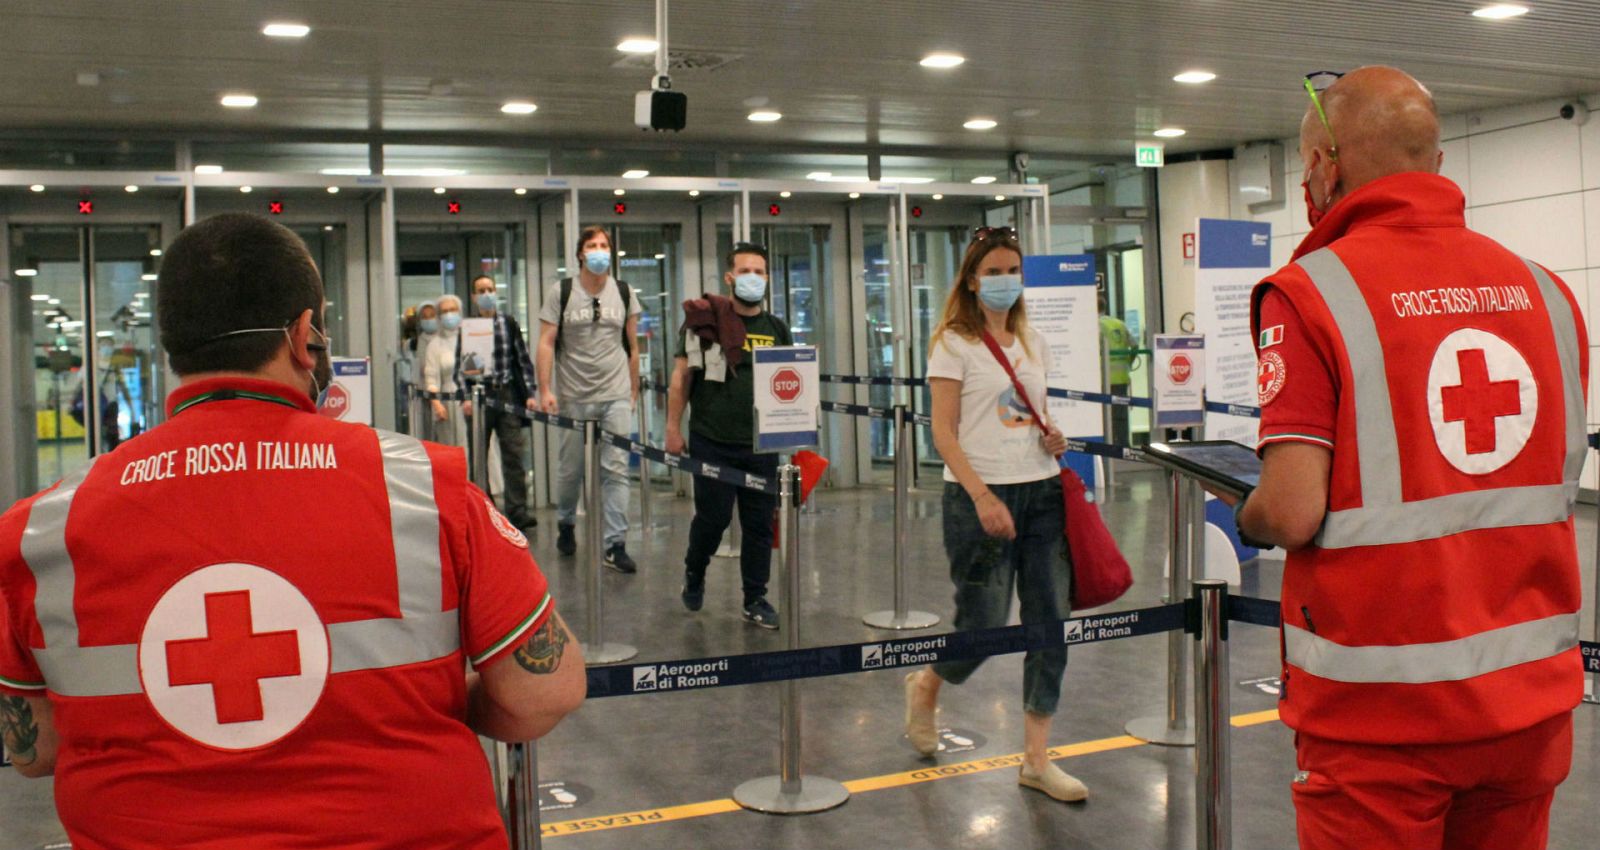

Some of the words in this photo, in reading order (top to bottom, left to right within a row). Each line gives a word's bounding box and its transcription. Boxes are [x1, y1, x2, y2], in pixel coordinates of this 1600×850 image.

[1391, 289, 1441, 318] CROCE
[1438, 287, 1480, 314] ROSSA
[1477, 285, 1533, 313] ITALIANA
[1170, 365, 1190, 375] STOP
[775, 381, 799, 391] STOP
[120, 450, 178, 486] CROCE
[185, 441, 247, 476] ROSSA
[256, 440, 338, 470] ITALIANA
[1083, 612, 1139, 630] Aeroporti
[1084, 629, 1095, 641] di
[1098, 626, 1132, 639] Roma
[884, 636, 947, 654] Aeroporti
[658, 659, 729, 676] Aeroporti
[884, 656, 897, 666] di
[901, 652, 938, 664] Roma
[658, 677, 672, 689] di
[677, 675, 719, 688] Roma
[911, 763, 978, 780] HOLD
[568, 811, 663, 831] PLEASE
